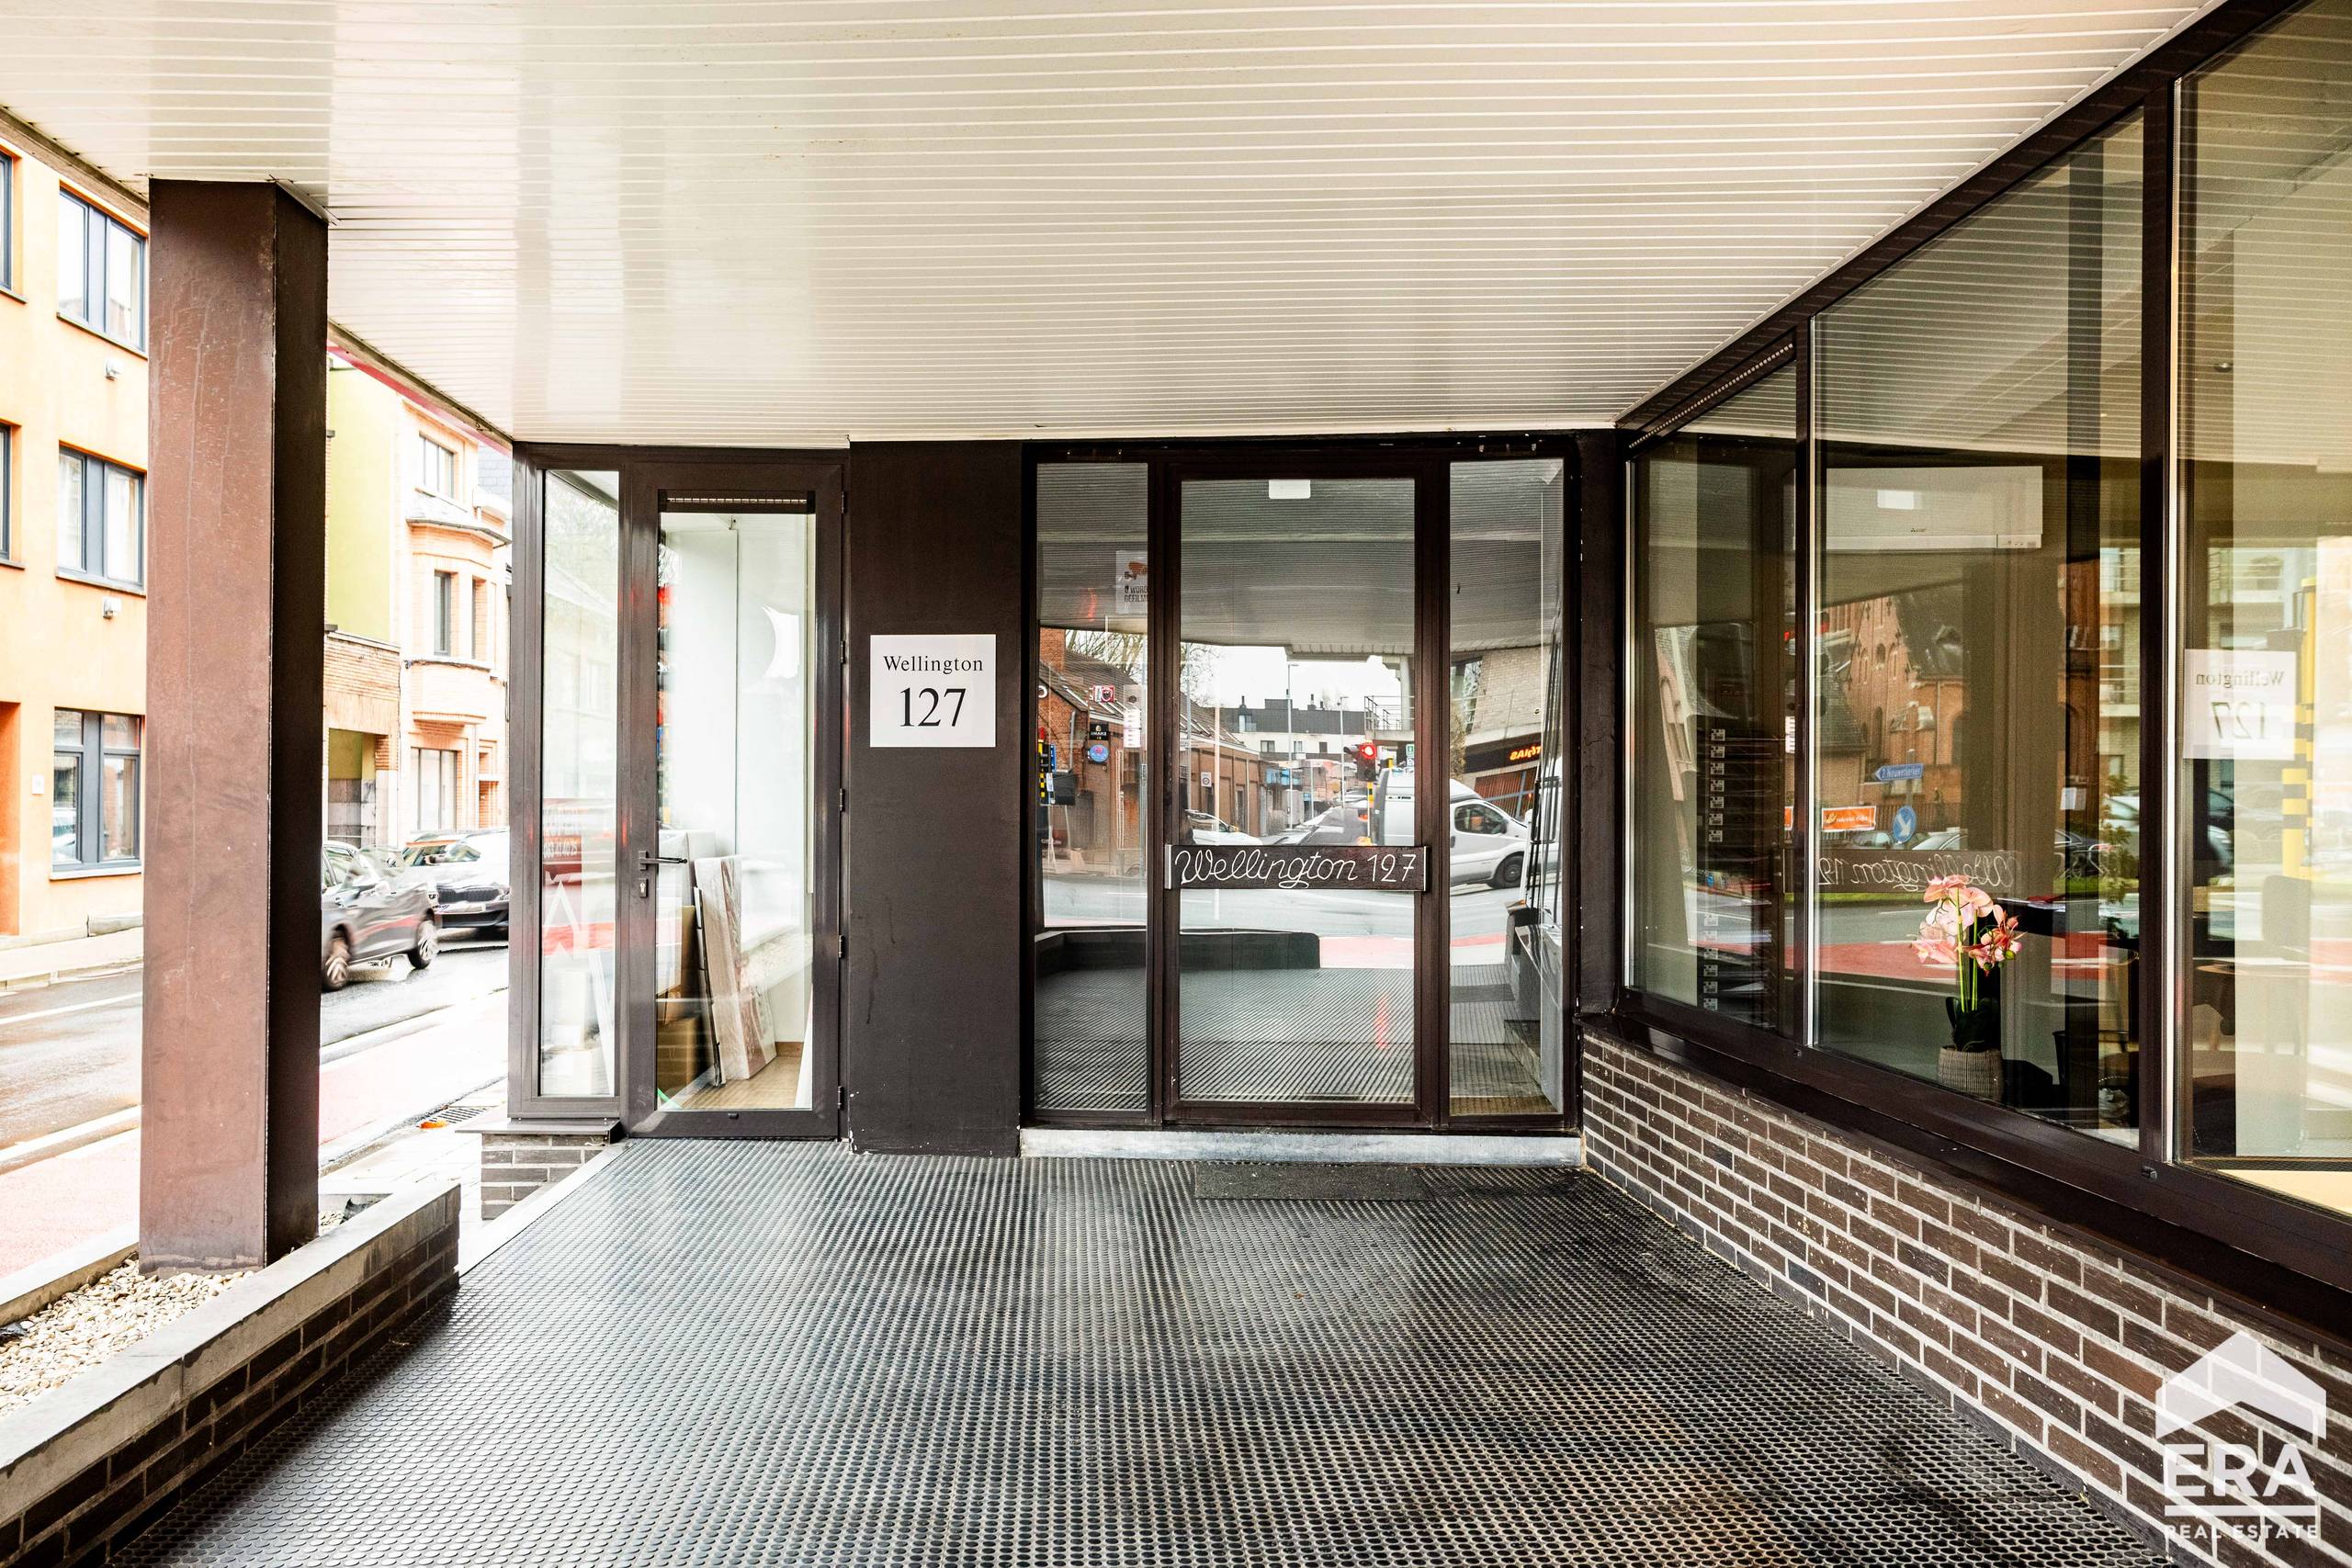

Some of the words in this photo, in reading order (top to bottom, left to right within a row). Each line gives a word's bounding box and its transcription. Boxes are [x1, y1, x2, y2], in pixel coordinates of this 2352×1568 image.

[1125, 594, 1148, 603] GEFILM
[883, 655, 984, 675] Wellington
[899, 687, 967, 728] 127
[1174, 848, 1359, 889] Wellington
[1367, 853, 1418, 883] 127
